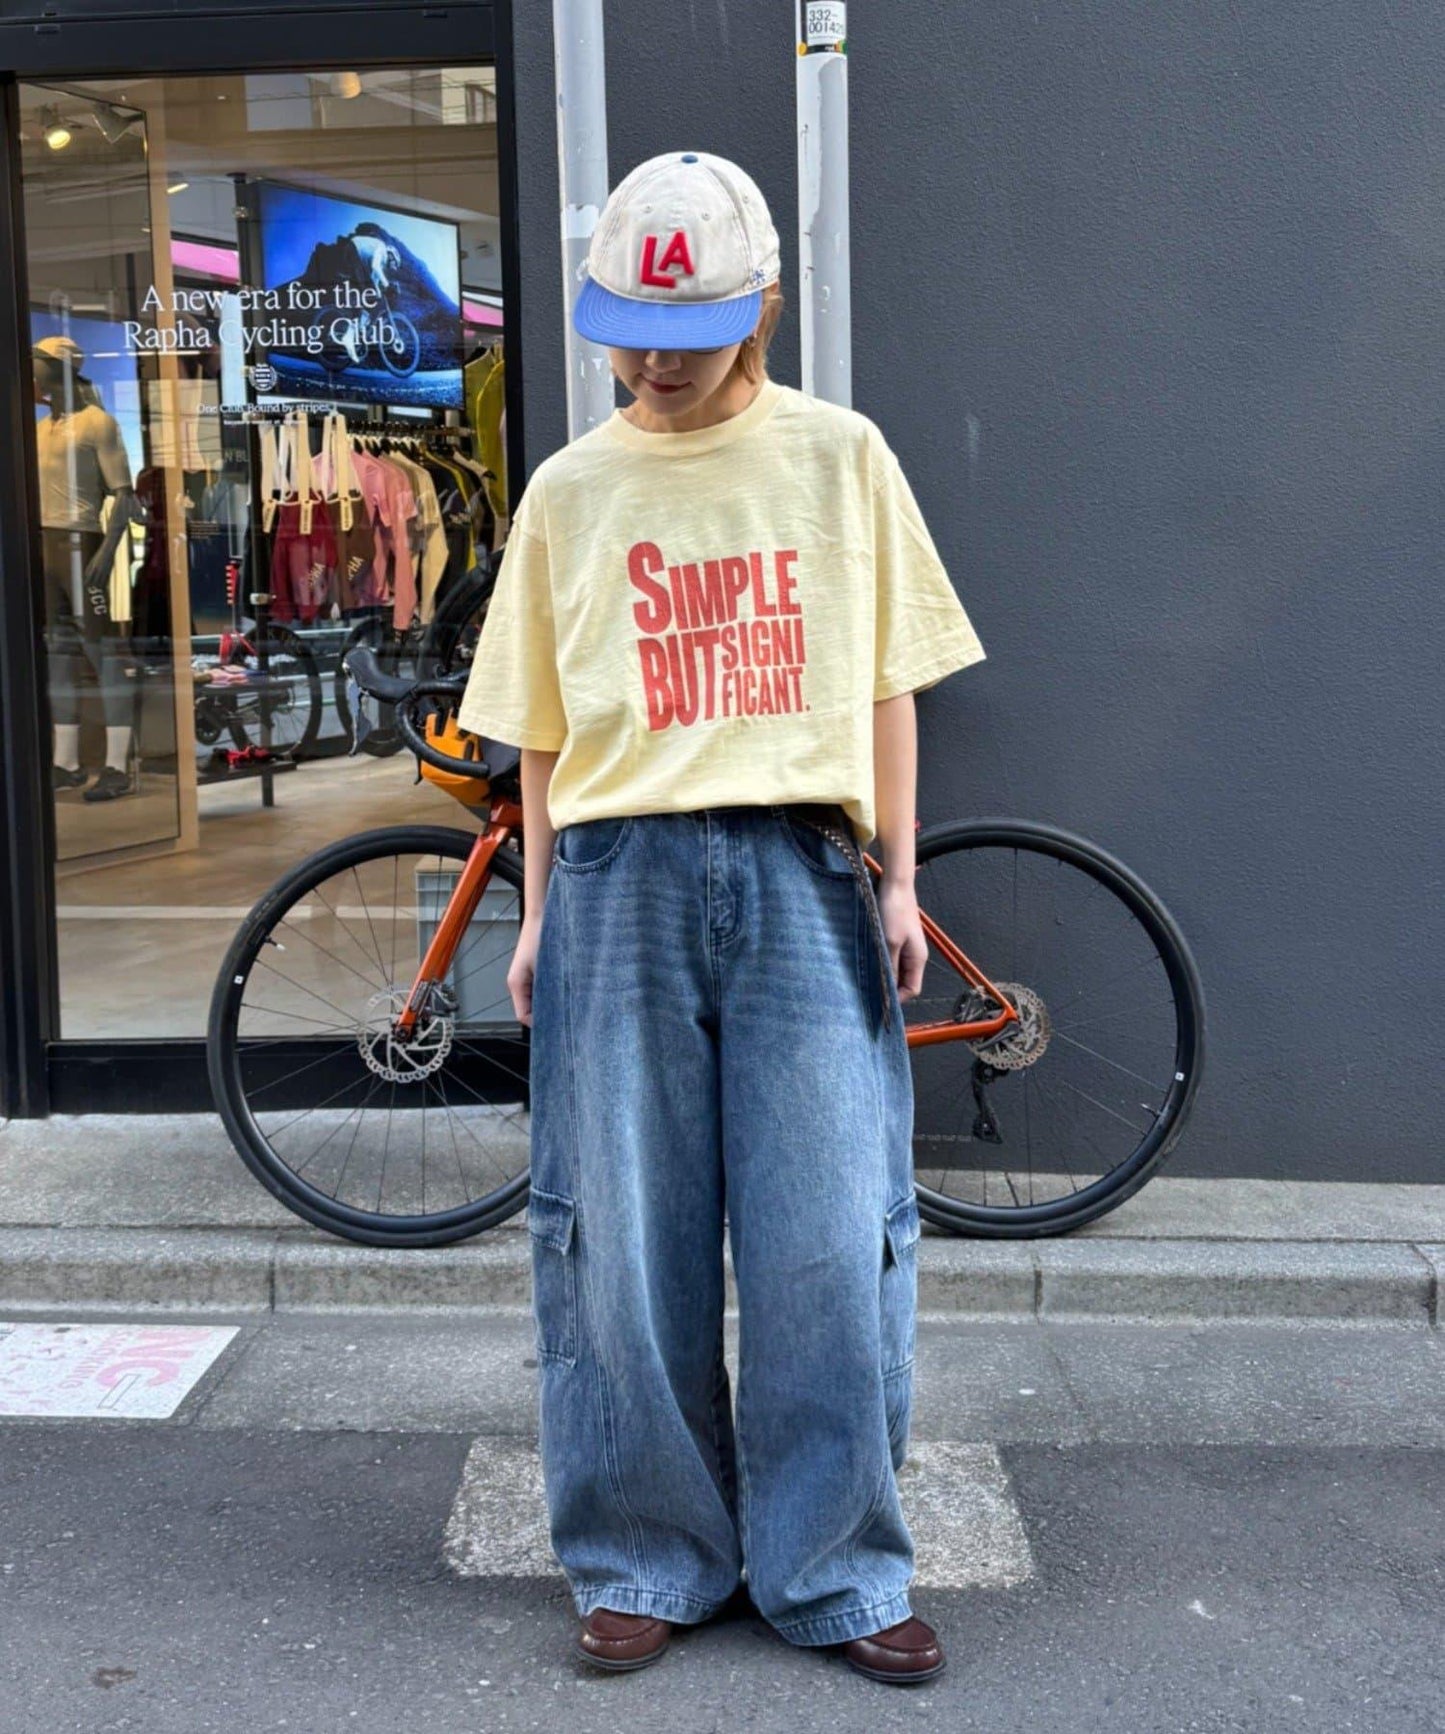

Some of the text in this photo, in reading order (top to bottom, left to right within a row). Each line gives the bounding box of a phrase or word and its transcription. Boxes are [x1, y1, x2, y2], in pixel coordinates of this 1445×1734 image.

[641, 231, 695, 289] LA
[141, 281, 378, 312] A new era for the
[123, 320, 213, 353] Rapha
[218, 318, 325, 354] Cycling
[281, 402, 293, 416] by
[627, 541, 802, 634] SIMPLE
[638, 619, 806, 731] BUT SIGNI
[722, 666, 810, 718] FICANT.
